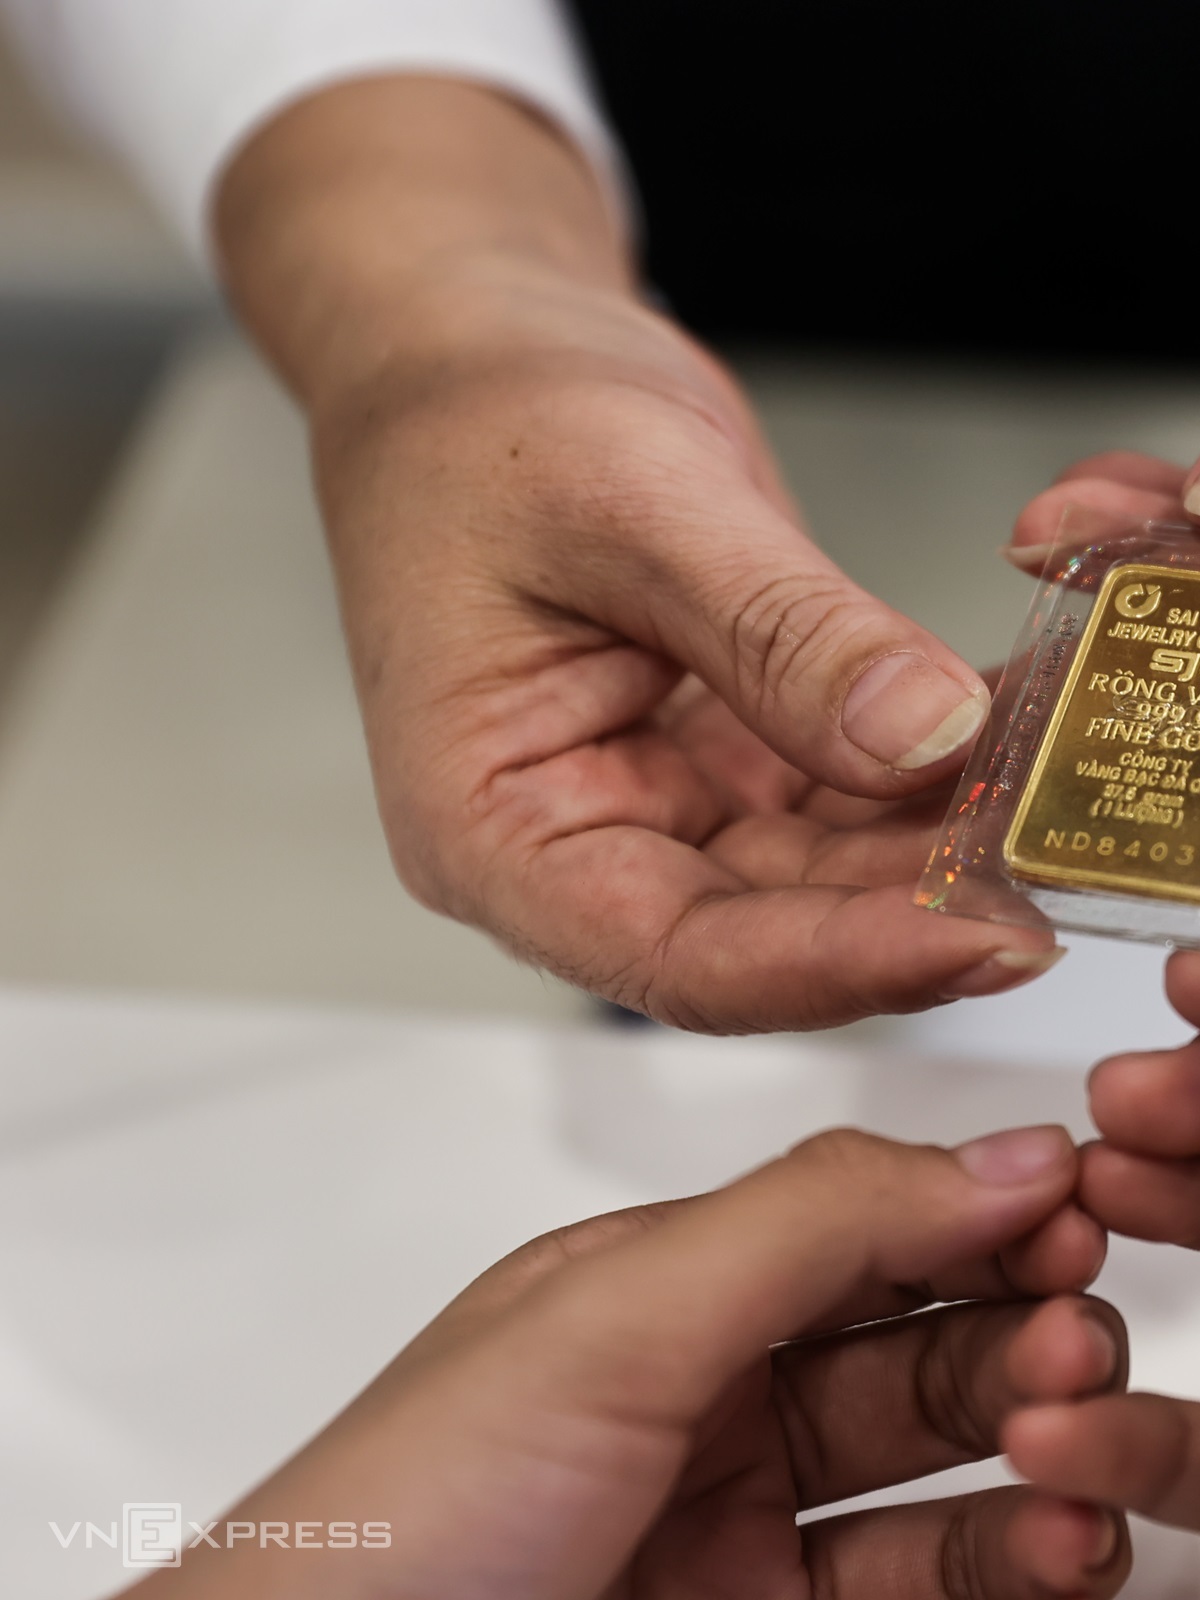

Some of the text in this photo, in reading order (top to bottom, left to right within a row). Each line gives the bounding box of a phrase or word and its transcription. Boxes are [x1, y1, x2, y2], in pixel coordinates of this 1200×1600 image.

[1166, 607, 1200, 626] SAI
[1107, 621, 1197, 648] JEWELRY
[1087, 668, 1178, 703] RỒNG
[1085, 716, 1155, 746] FINE
[1076, 759, 1122, 781] VÀNG
[1118, 749, 1168, 771] CÔNG
